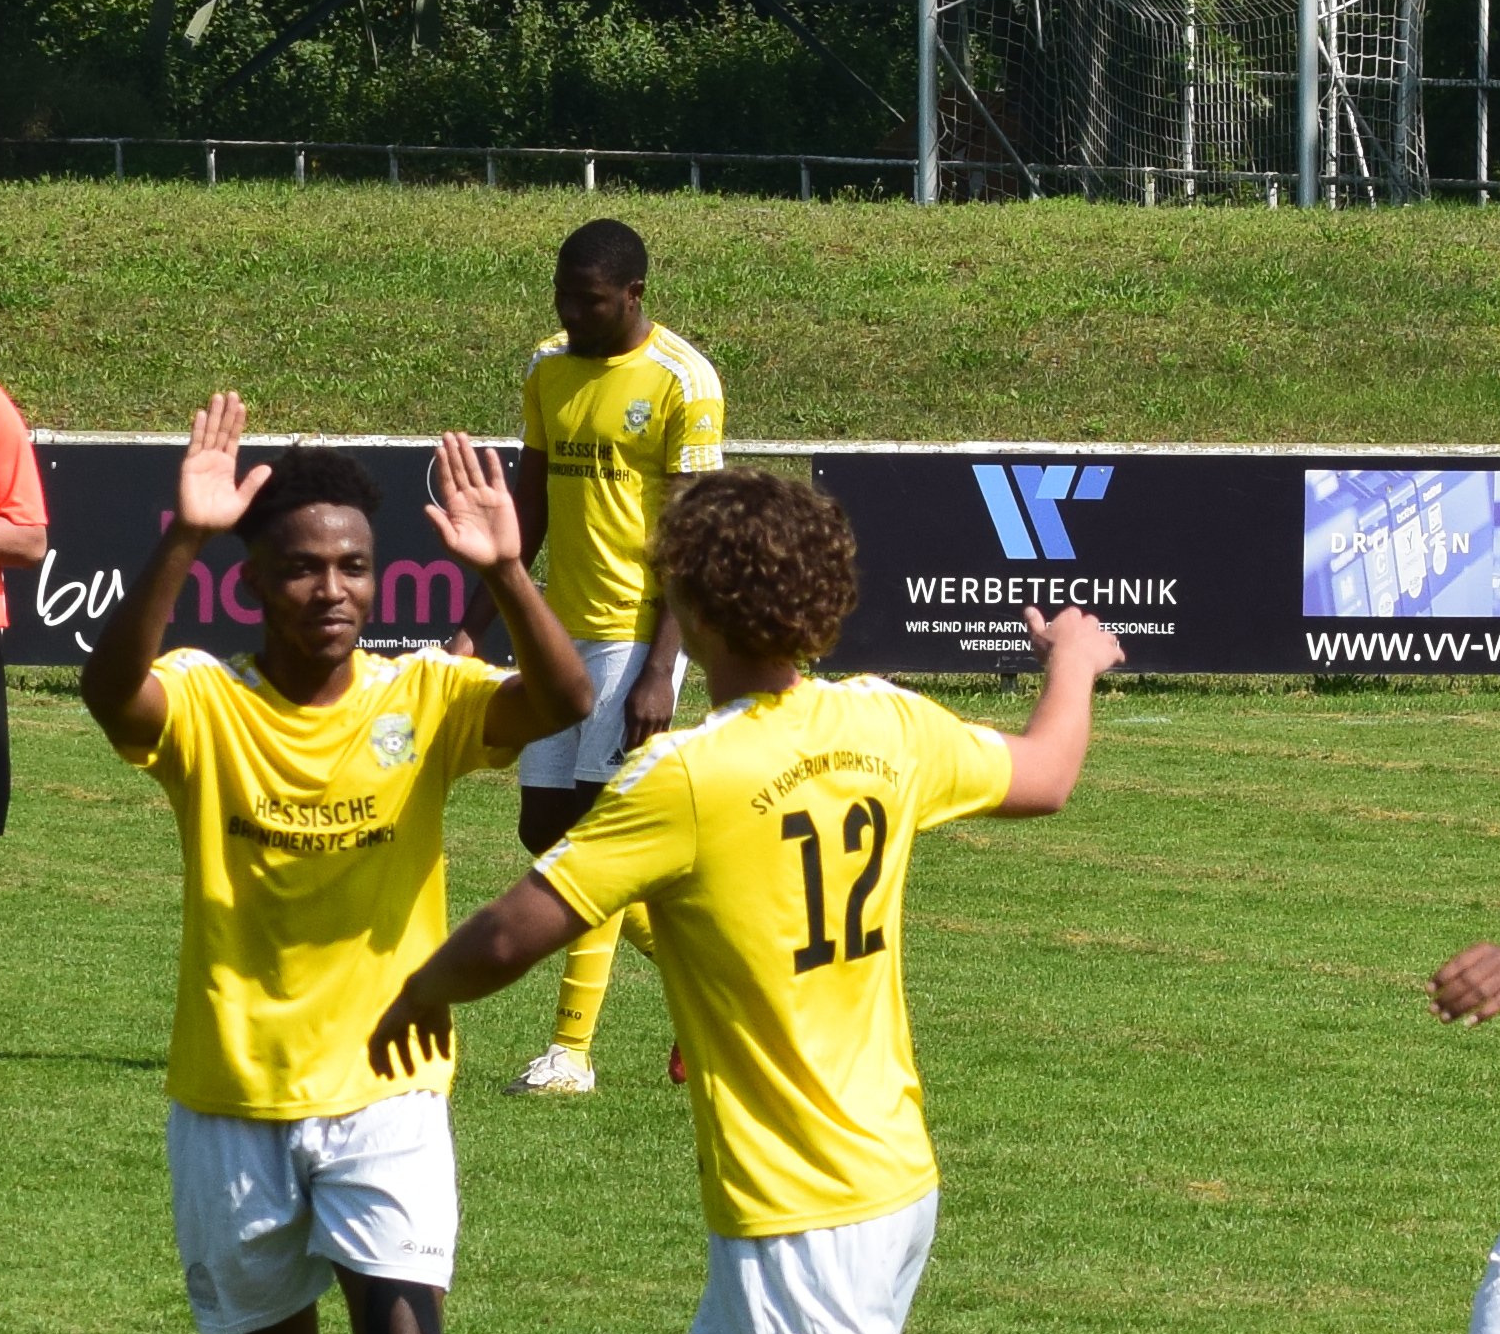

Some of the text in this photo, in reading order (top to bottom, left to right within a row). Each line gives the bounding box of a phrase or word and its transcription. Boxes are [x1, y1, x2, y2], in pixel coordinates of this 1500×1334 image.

[1331, 532, 1470, 554] DRUKEN
[905, 576, 1178, 606] WERBETECHNIK
[905, 621, 1176, 635] WIR SIND IHR PARTN FESSIONELLE
[960, 639, 1035, 652] WERBEDIEN
[750, 787, 775, 816] SV
[772, 752, 831, 798] KAMERUN
[255, 794, 378, 829] HESSISCHE
[780, 794, 887, 976] 12
[419, 1245, 445, 1258] JAKO
